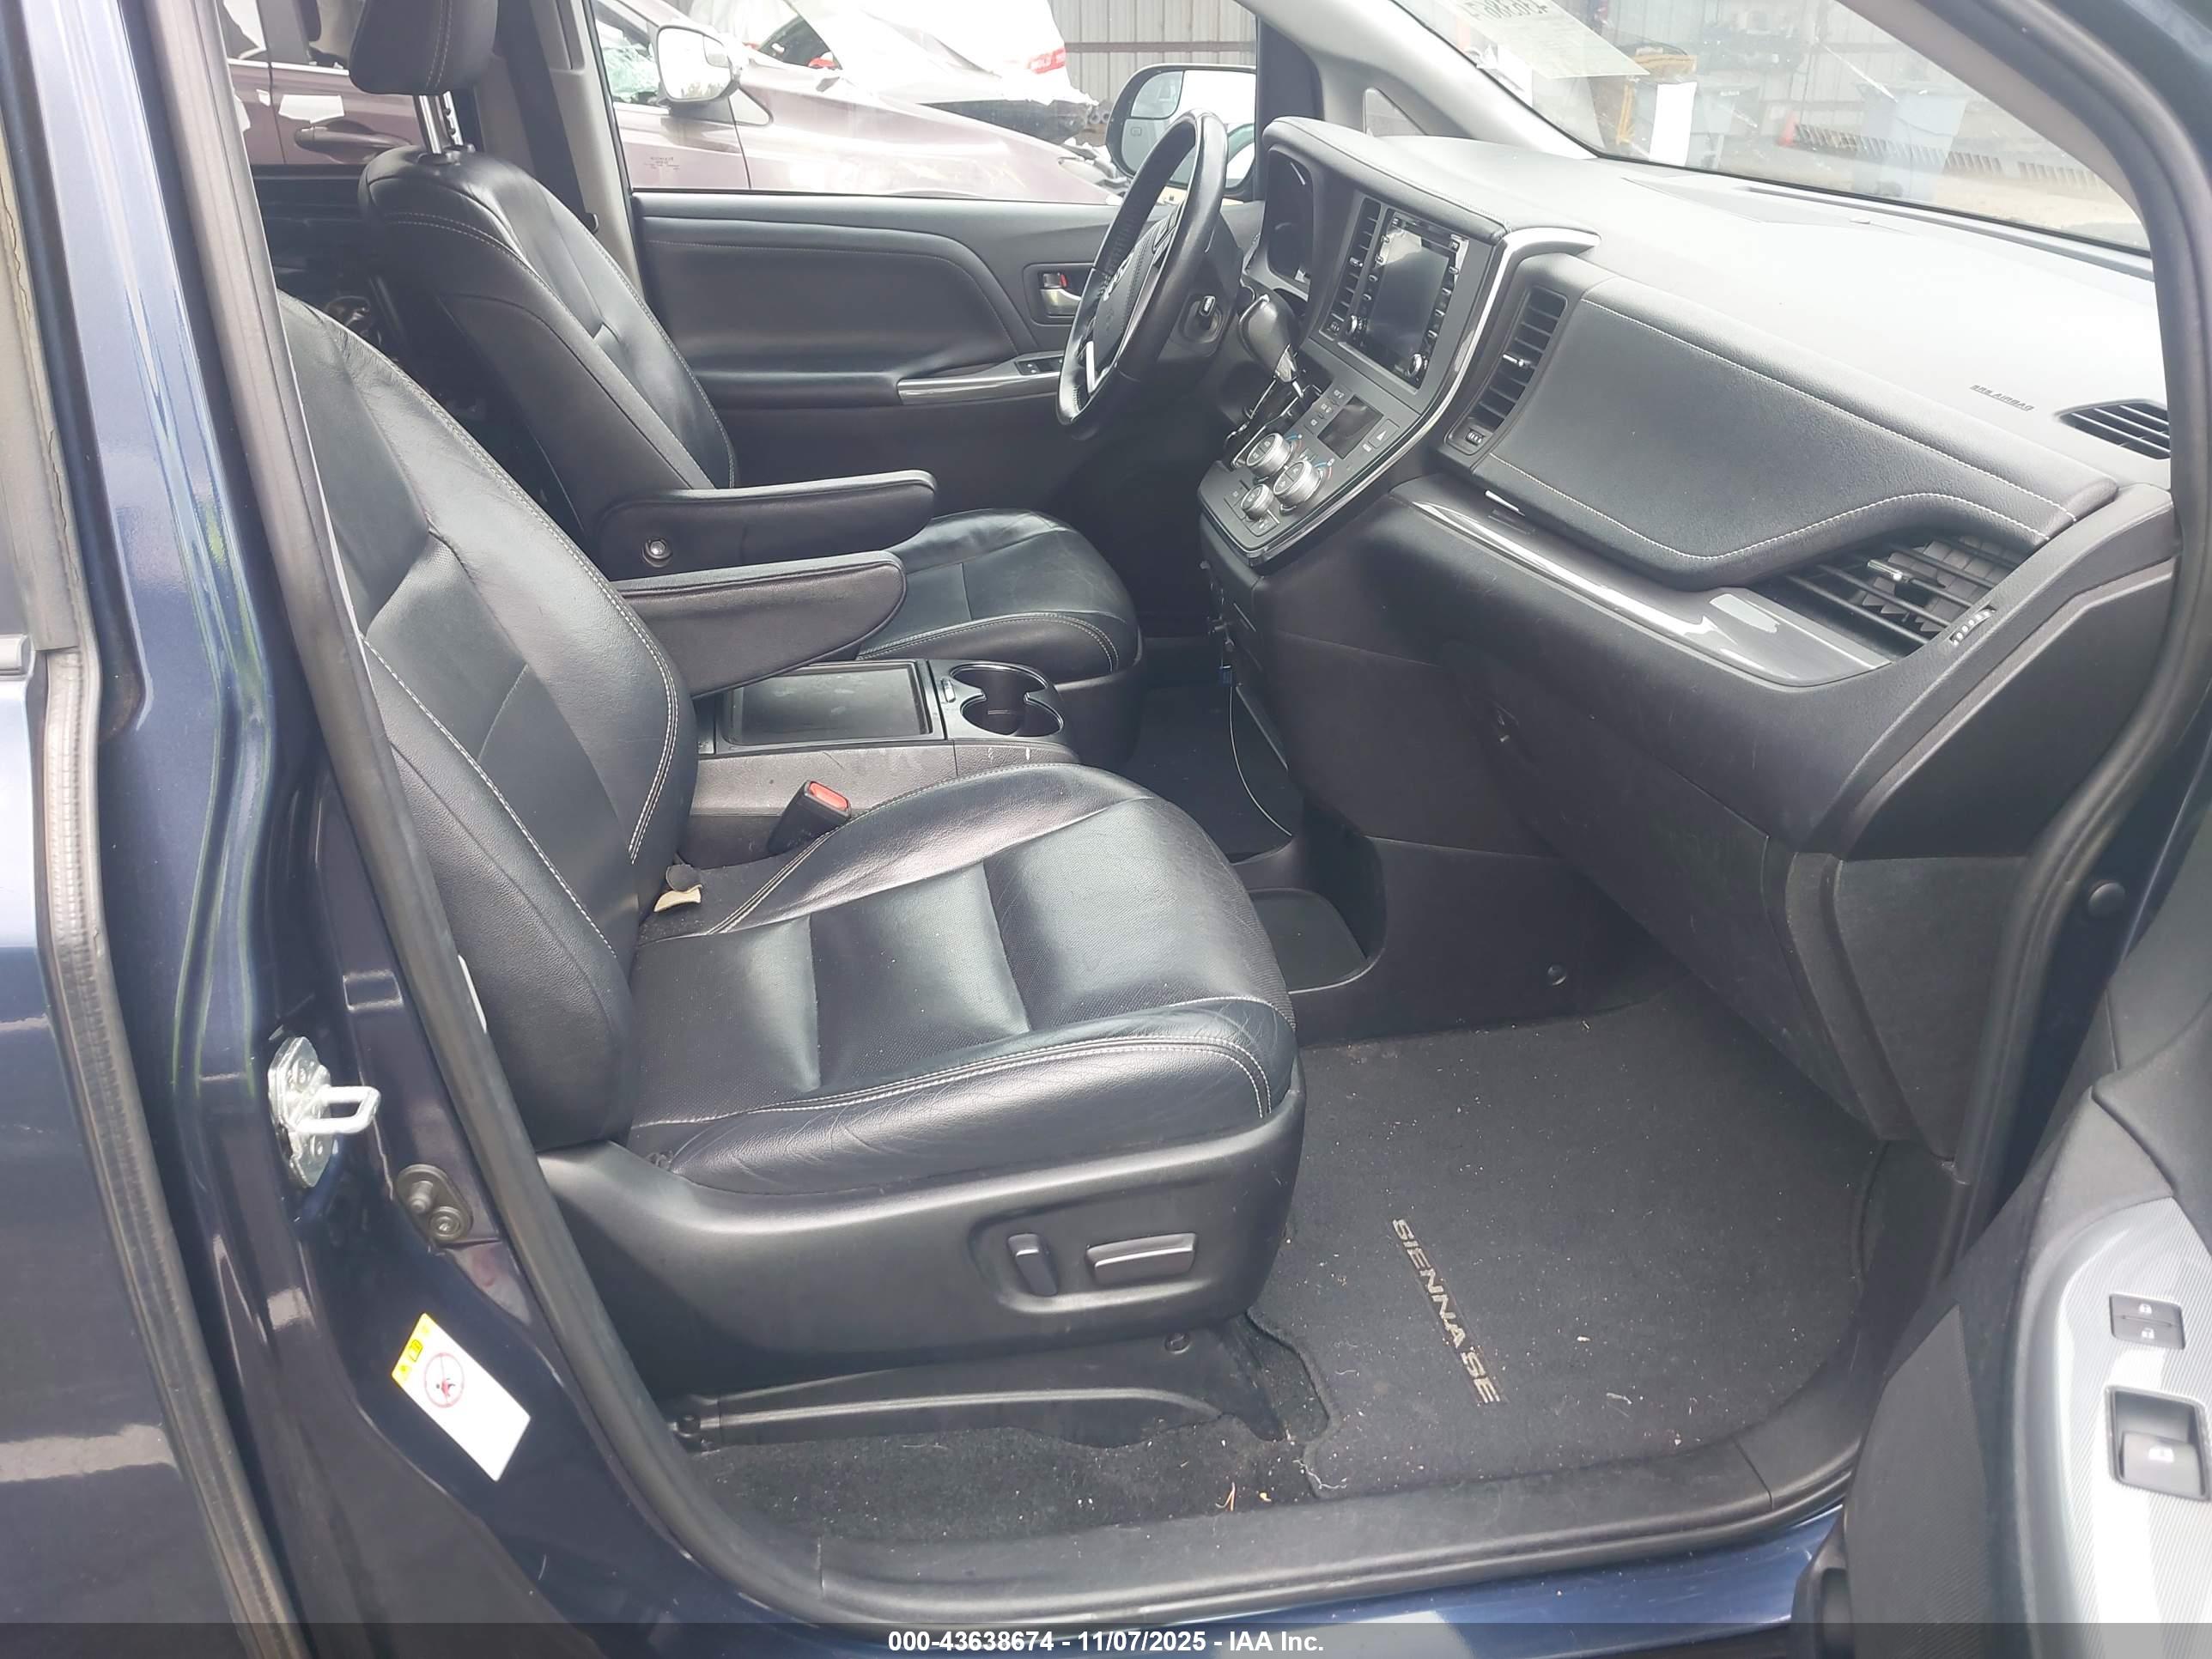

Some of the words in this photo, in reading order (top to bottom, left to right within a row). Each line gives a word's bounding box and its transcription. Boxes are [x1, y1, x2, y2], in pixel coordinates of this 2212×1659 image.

[1993, 392, 2034, 411] AIRBAG
[1392, 1218, 1465, 1349] SIENNA
[1461, 1351, 1500, 1403] SE
